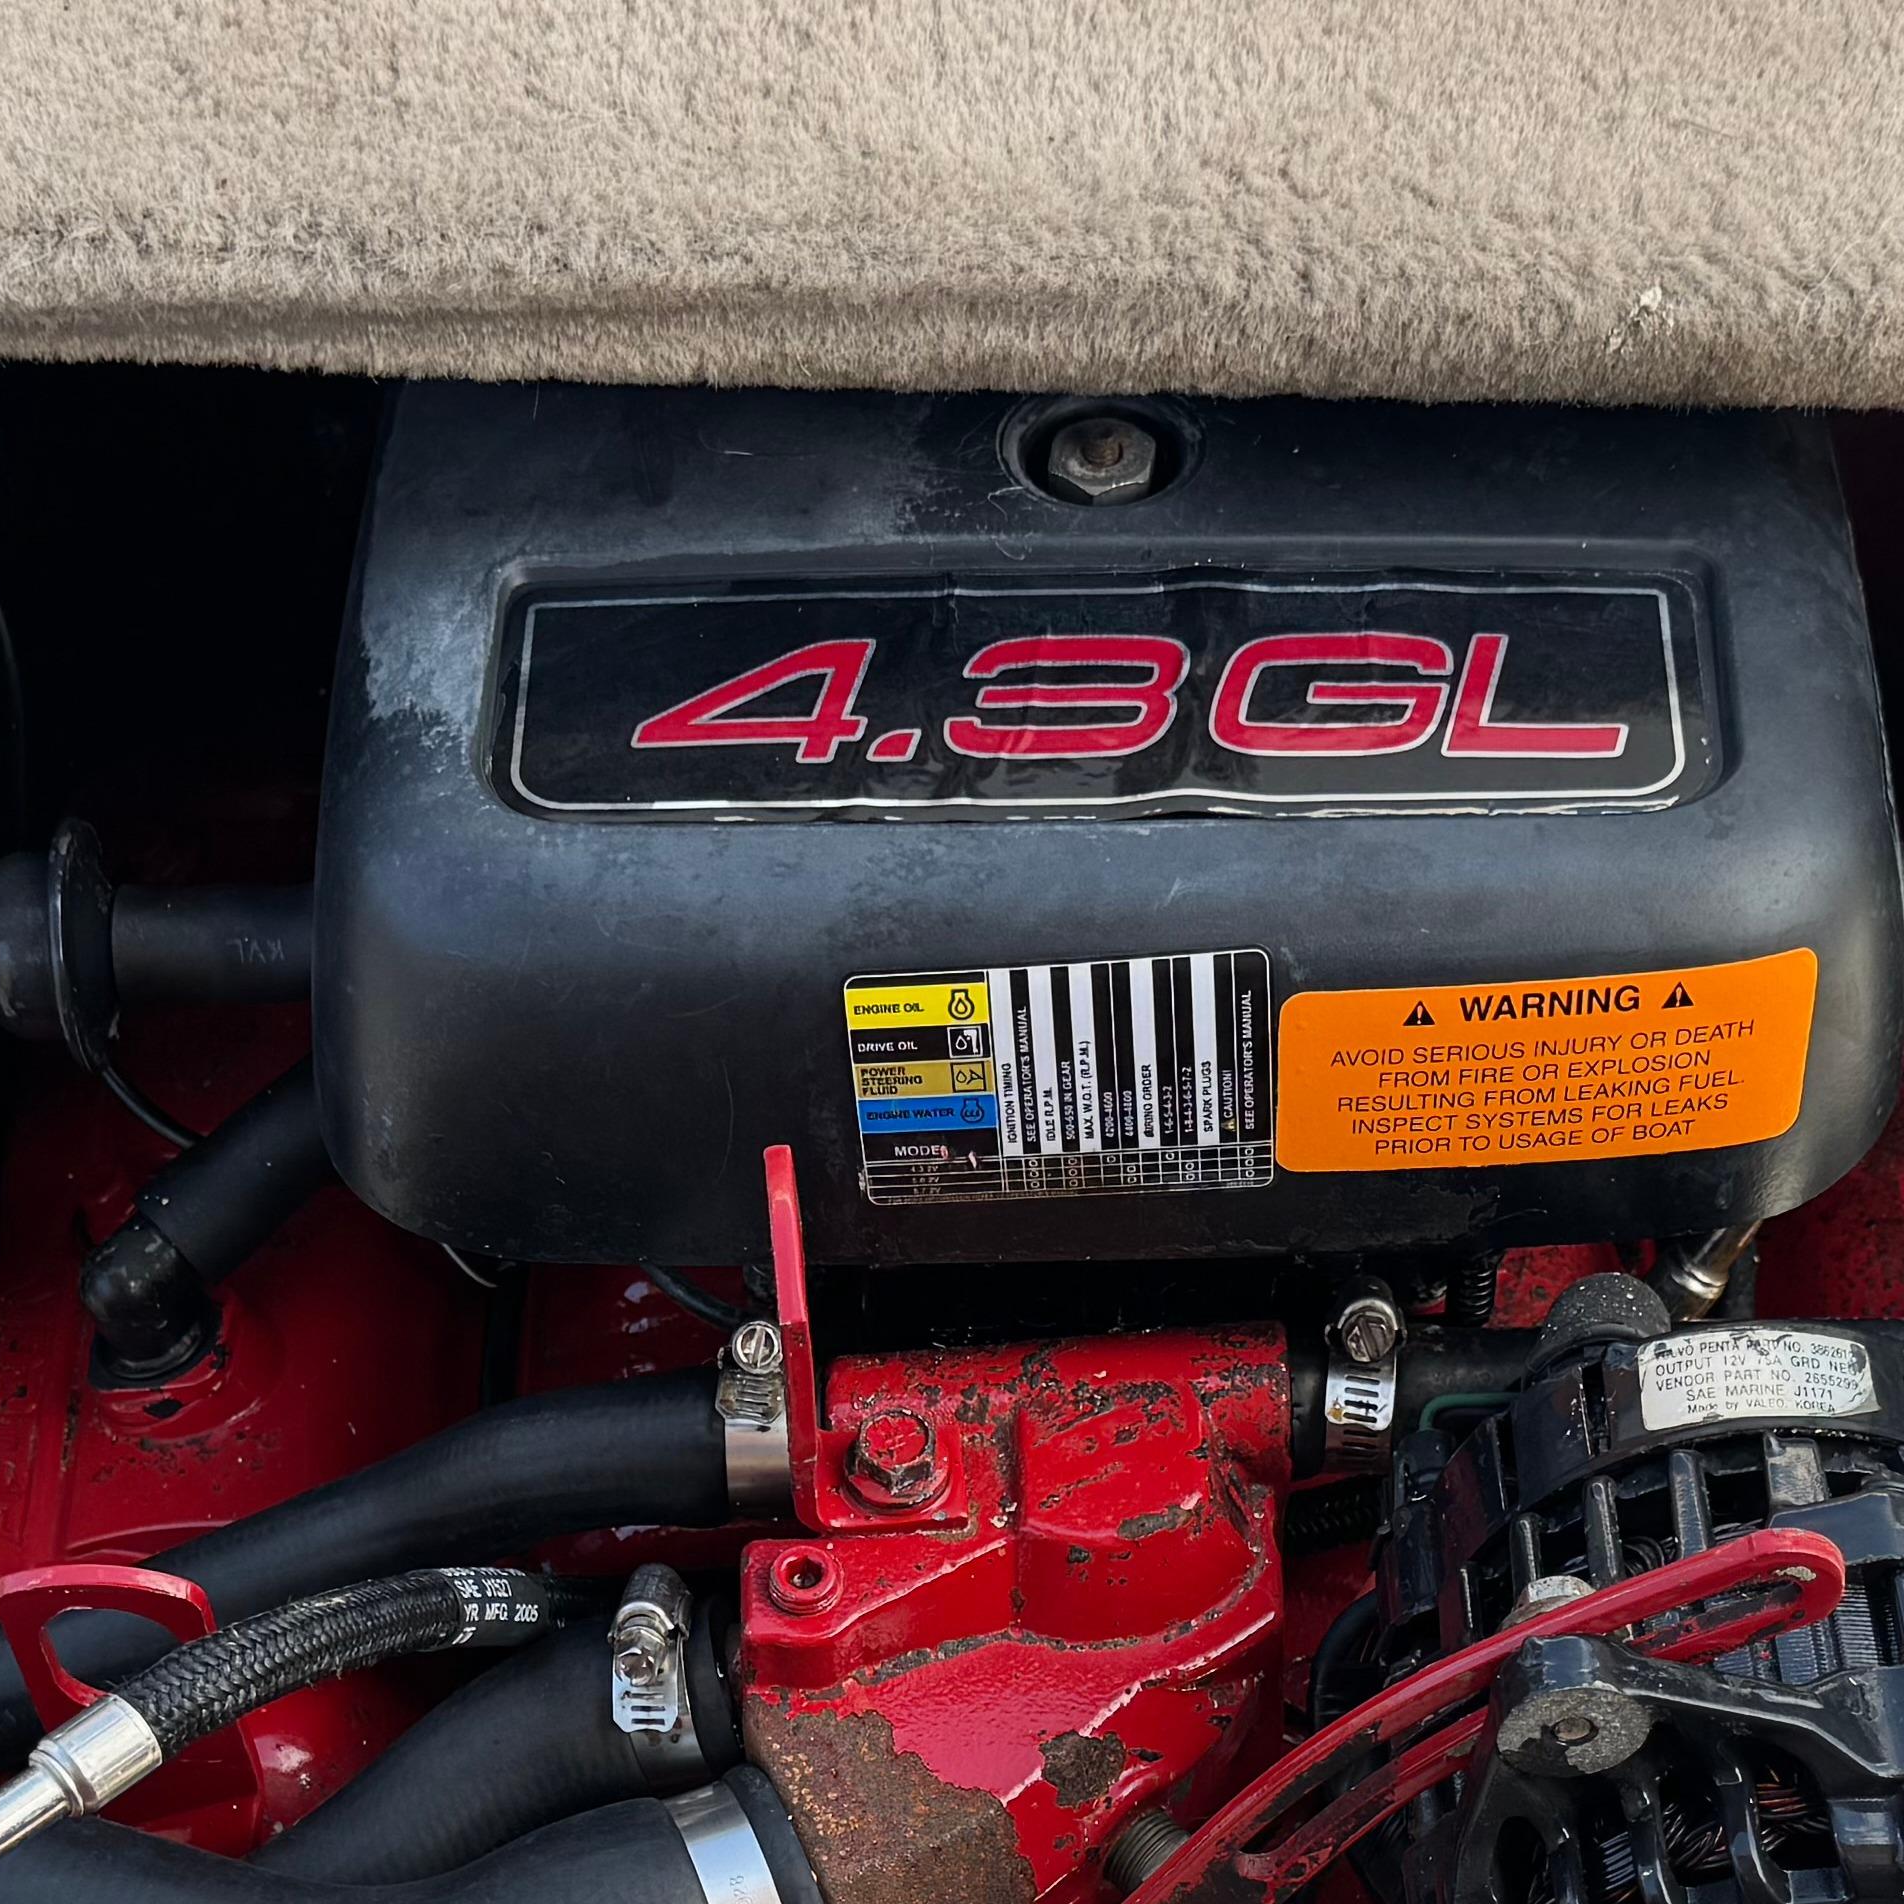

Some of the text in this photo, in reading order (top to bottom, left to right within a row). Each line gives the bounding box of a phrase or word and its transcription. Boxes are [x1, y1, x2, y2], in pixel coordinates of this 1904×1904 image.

[631, 631, 1629, 764] 4.3GL
[853, 1002, 925, 1016] ENGINE OIL
[1459, 984, 1640, 1022] WARNING
[857, 1040, 918, 1053] DRIVE OIL
[1330, 1018, 1755, 1067] AVOID SERIOUS INJURY OR DEATH
[860, 1066, 906, 1077] POWER
[1241, 989, 1255, 1130] SEE OPERATOR'S MANUAL
[1379, 1049, 1711, 1088] FROM FIRE OR EXPLOSION
[861, 1074, 923, 1087] STEERING
[1016, 1005, 1037, 1143] SEE OPERATOR'S MANUAL
[1061, 1061, 1072, 1090] GEAR
[1140, 1064, 1152, 1101] ORDER
[862, 1086, 898, 1097] FLUID
[1063, 1092, 1073, 1103] IN
[1081, 1081, 1093, 1114] W.O.T.
[1201, 1060, 1213, 1133] SPARK PLUGS
[1337, 1069, 1745, 1112] RESULTING FROM LEAKING FUEL.
[866, 1107, 955, 1121] ENGINE WATER
[1000, 1062, 1017, 1144] IGNITION TIMING
[1352, 1092, 1729, 1135] INSPECT SYSTEMS FOR LEAKS
[1045, 1118, 1056, 1142] IDLE
[1375, 1118, 1696, 1155] PRIOR TO USAGE OF BOAT
[1699, 1340, 1740, 1354] PENTA
[1783, 1341, 1805, 1353] NO.
[1655, 1356, 1712, 1377] OUTPUT
[1724, 1354, 1746, 1367] 12V
[1790, 1355, 1821, 1369] GRD
[1655, 1371, 1715, 1392] VENDOR
[1724, 1369, 1761, 1382] PART
[1686, 1384, 1833, 1402] SAE MARINE J1171
[1725, 1401, 1739, 1411] by
[1796, 1400, 1836, 1413] KOREA
[454, 1578, 513, 1599] SAE J1527
[463, 1602, 480, 1622] YR
